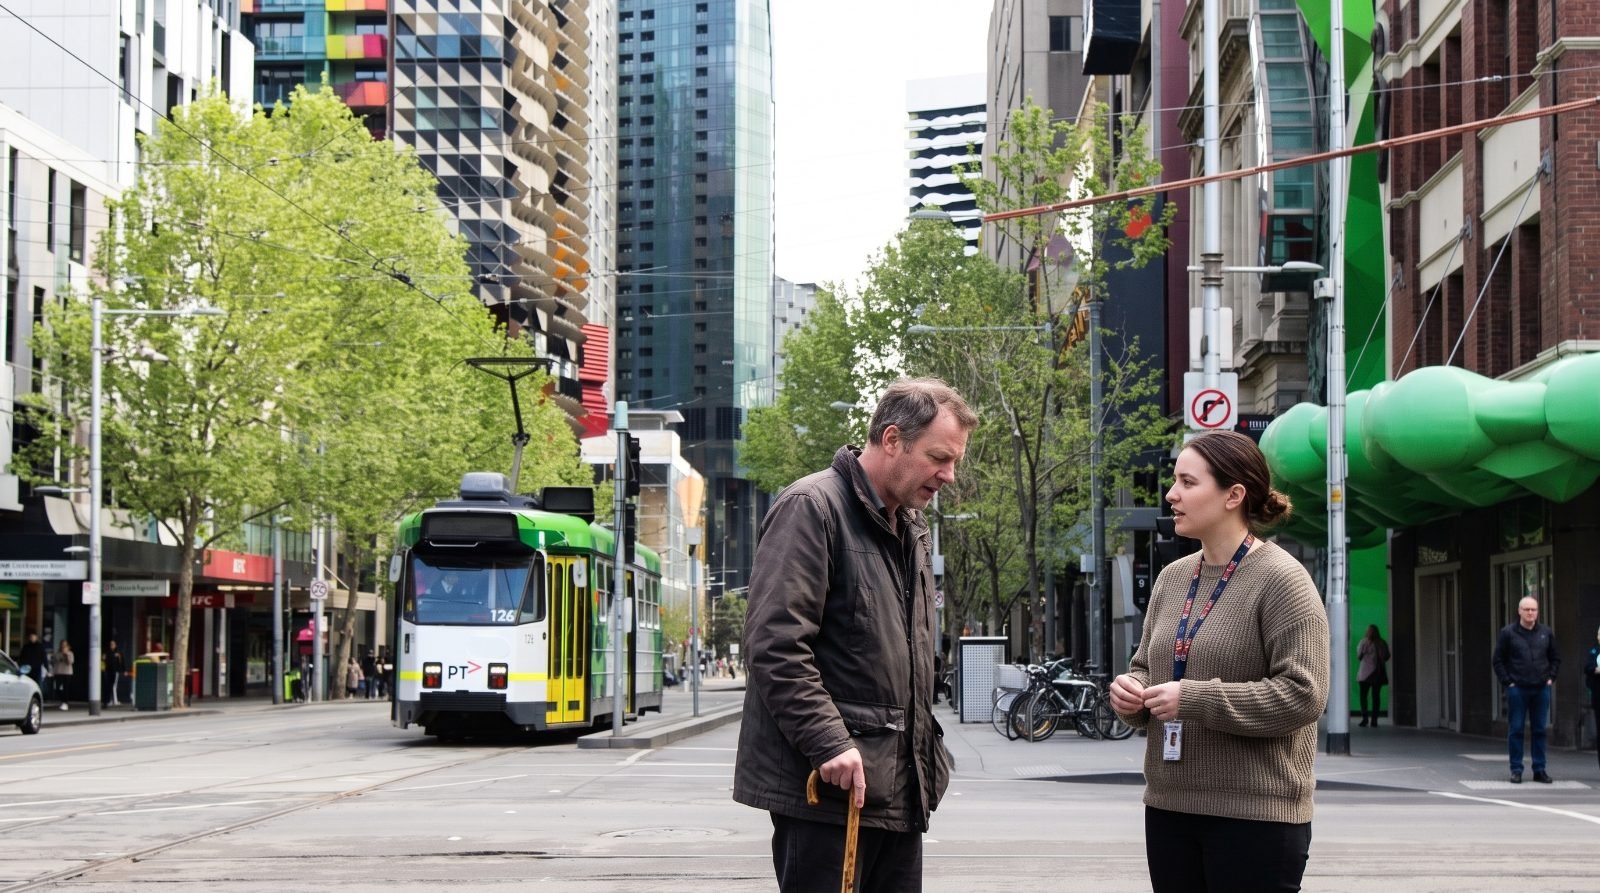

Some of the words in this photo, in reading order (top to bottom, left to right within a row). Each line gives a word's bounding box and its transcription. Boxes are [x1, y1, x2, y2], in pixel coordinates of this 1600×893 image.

[1138, 579, 1145, 588] 9
[490, 609, 515, 622] 126
[448, 665, 468, 680] PT
